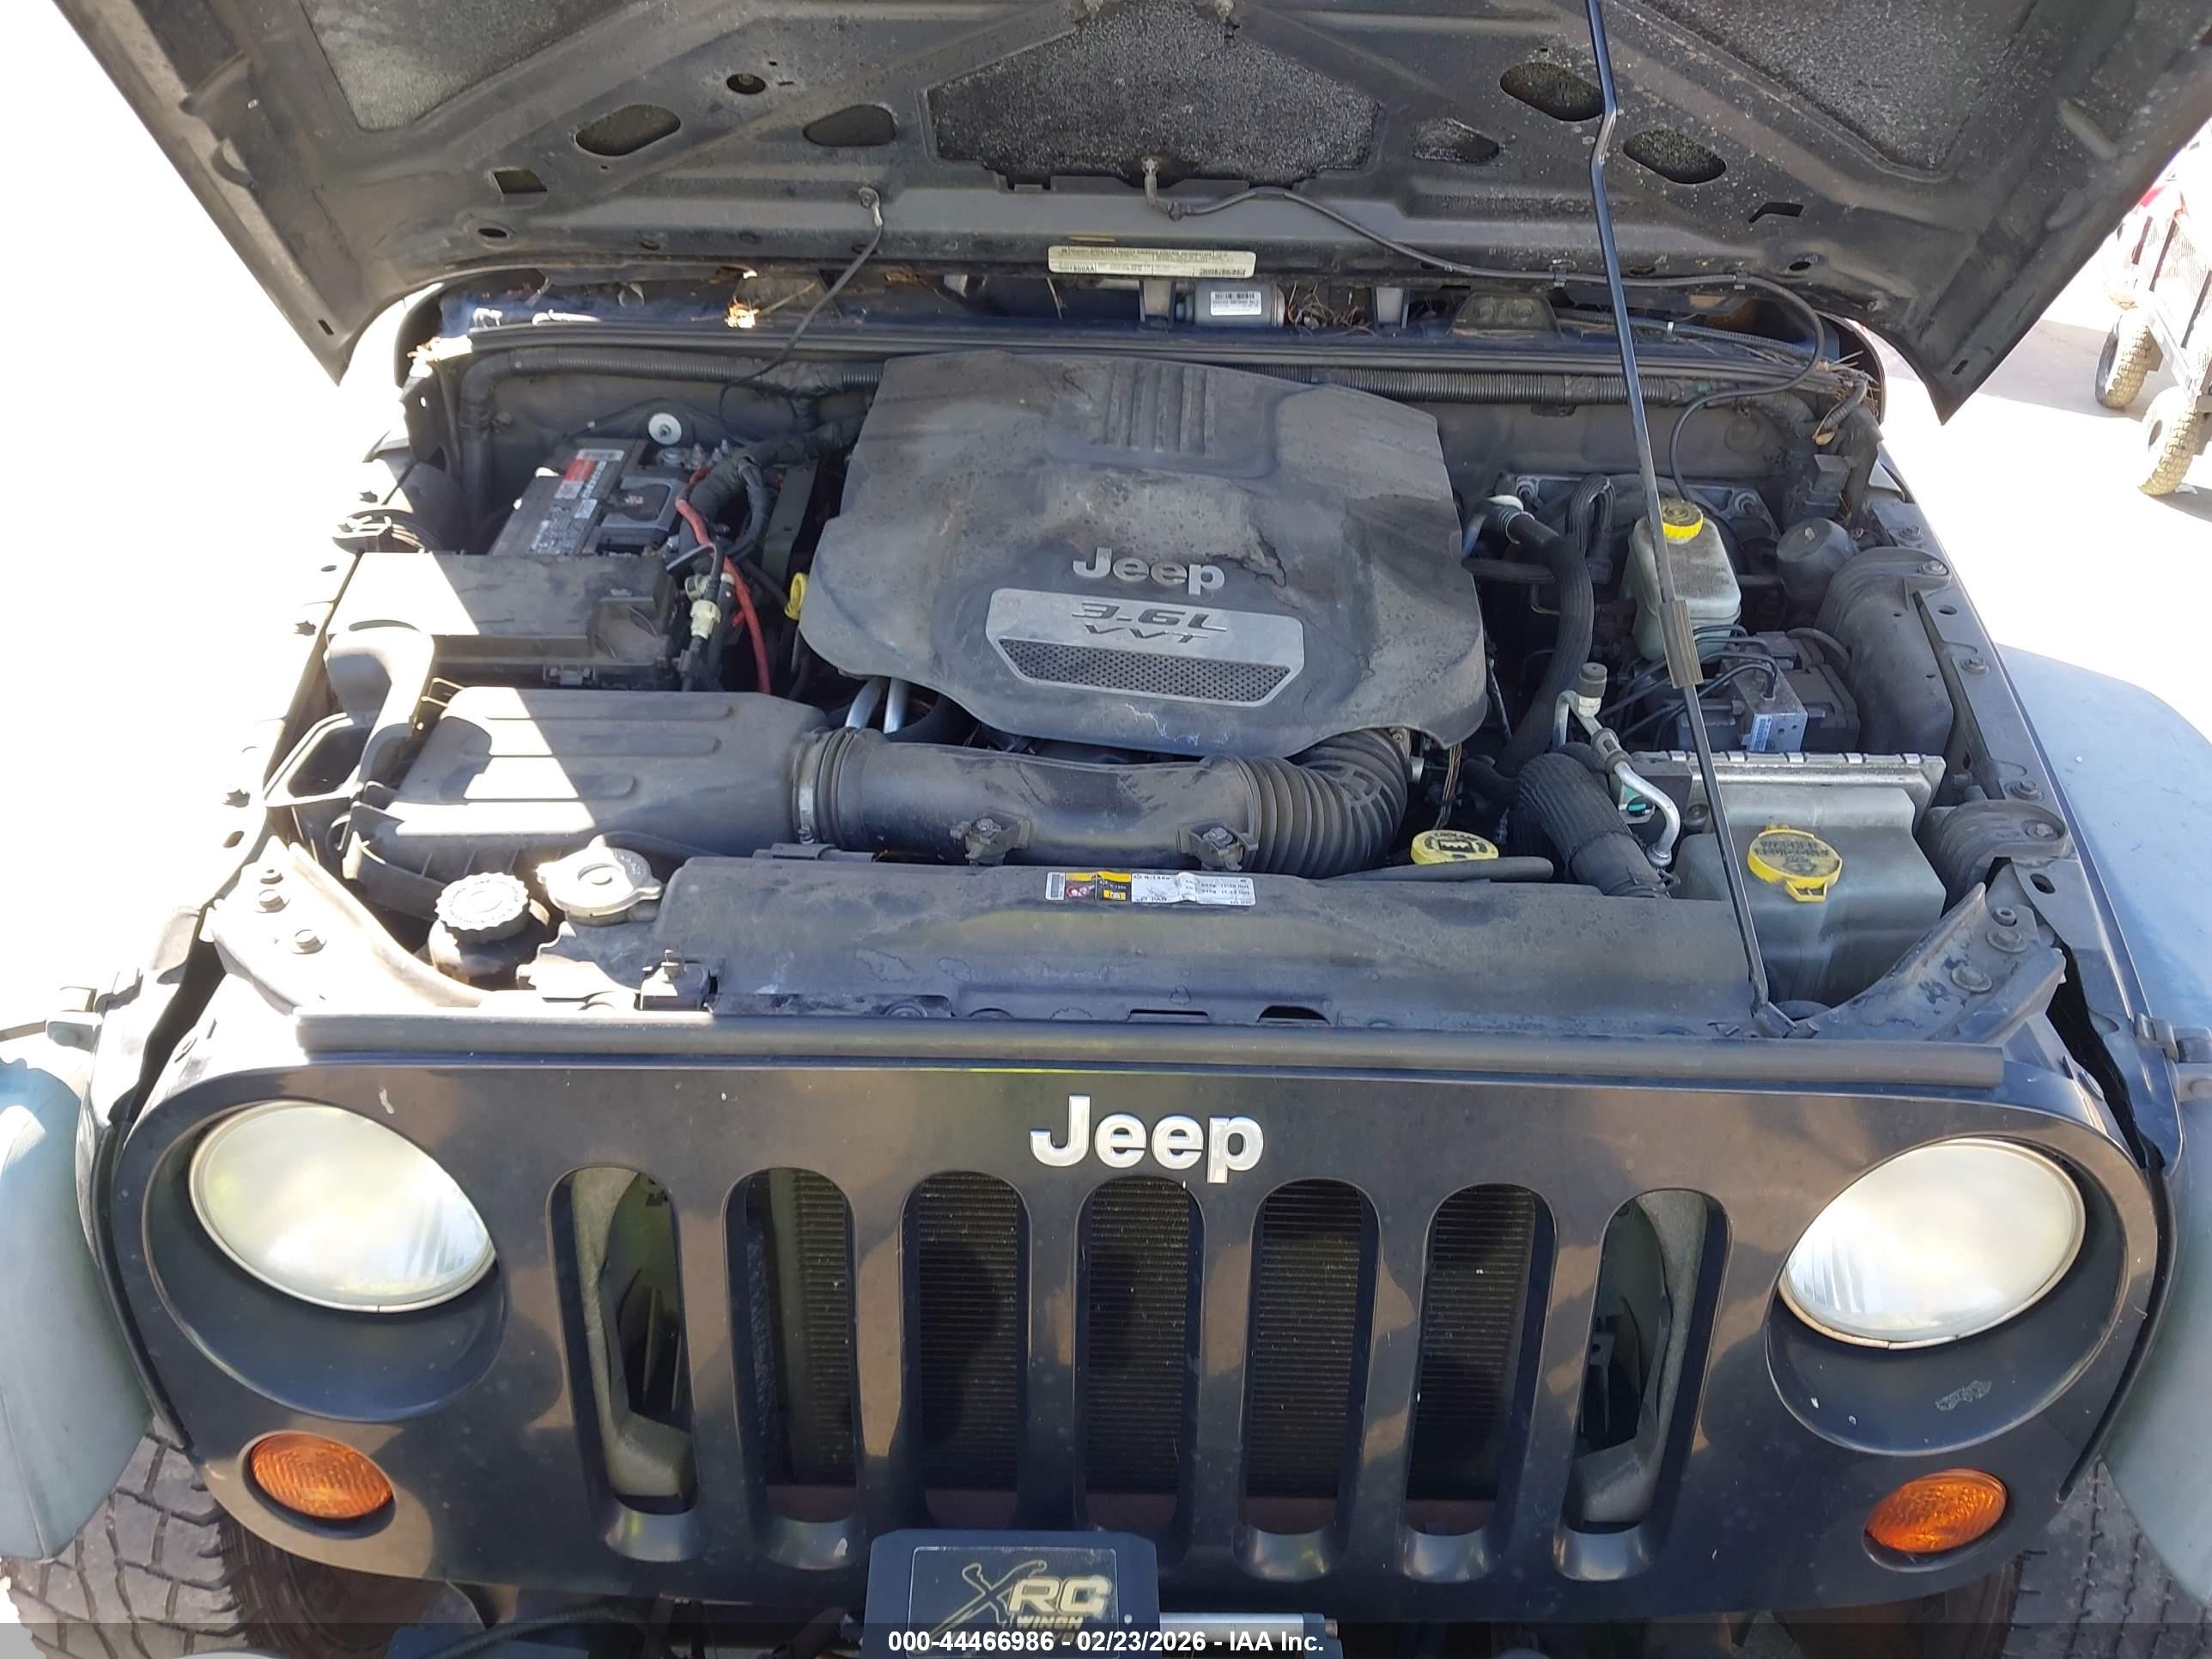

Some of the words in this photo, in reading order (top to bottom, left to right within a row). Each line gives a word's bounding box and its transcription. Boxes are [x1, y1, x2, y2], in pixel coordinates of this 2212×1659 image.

[1072, 546, 1225, 596] Jeep
[1071, 603, 1227, 632] 3.6L
[1085, 623, 1210, 644] VVT
[1030, 1094, 1264, 1183] Jeep
